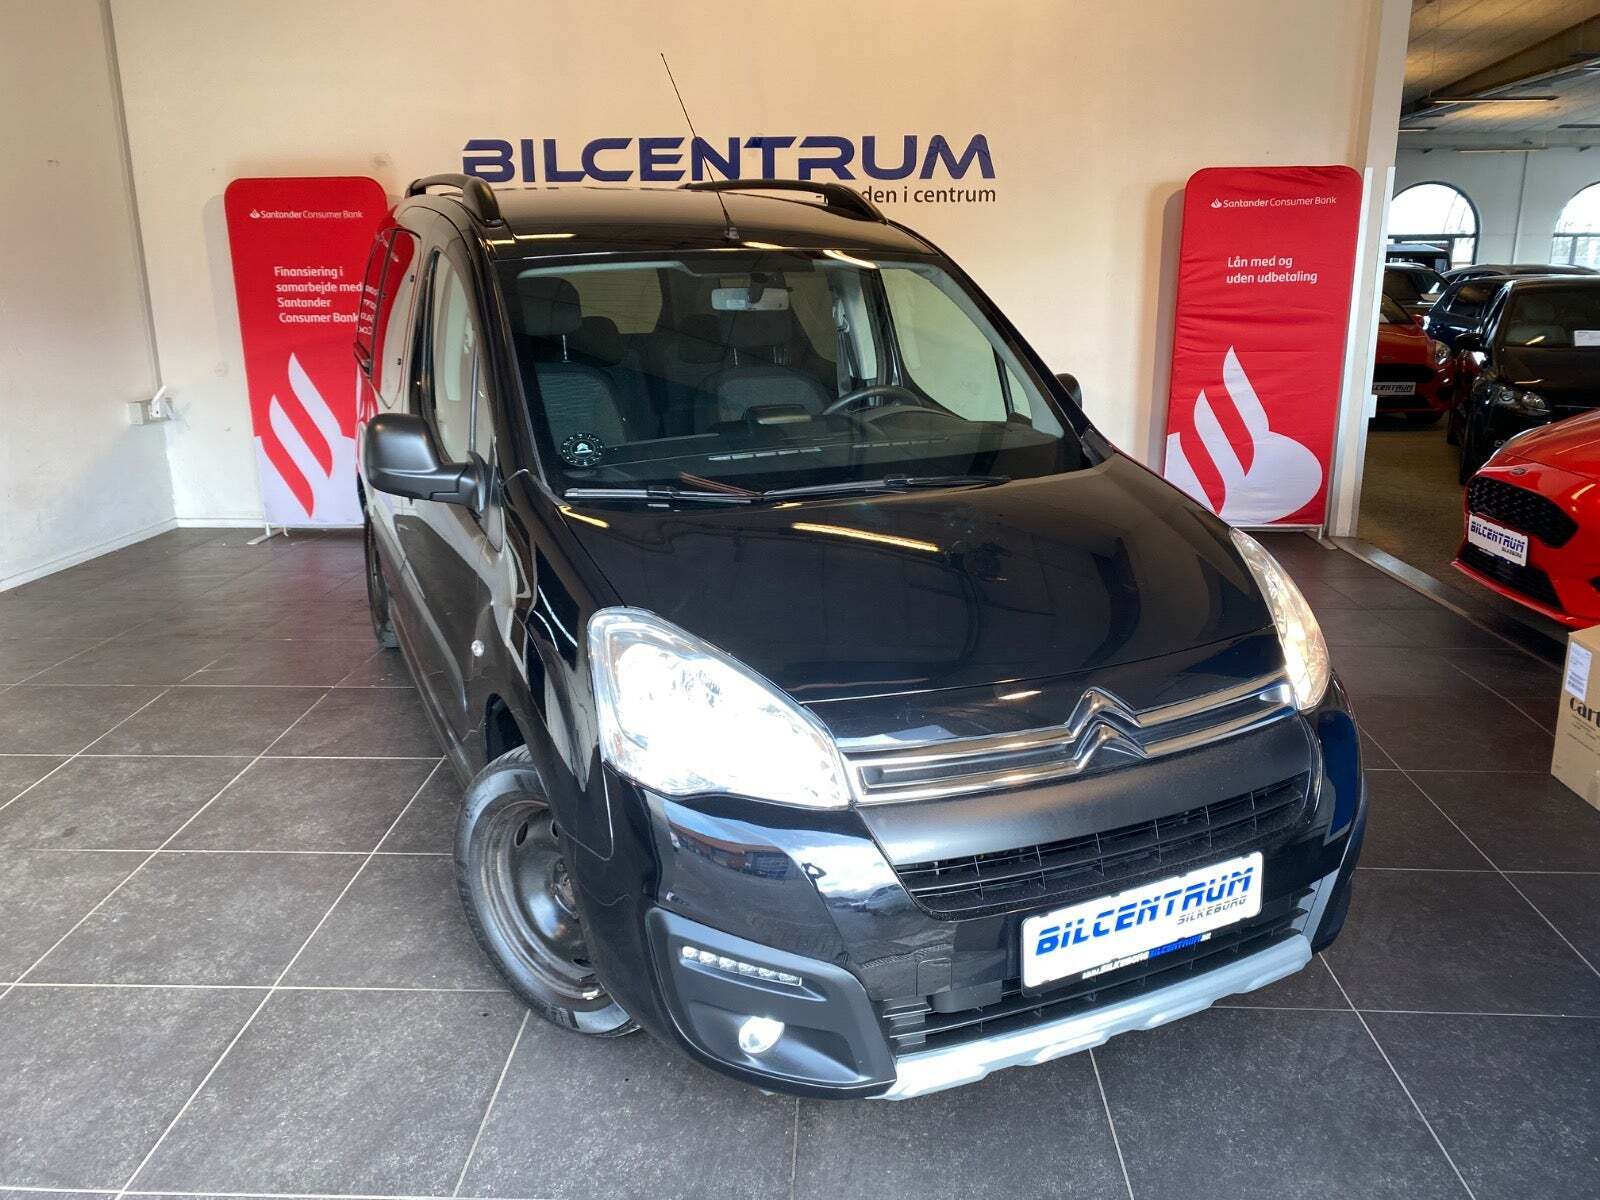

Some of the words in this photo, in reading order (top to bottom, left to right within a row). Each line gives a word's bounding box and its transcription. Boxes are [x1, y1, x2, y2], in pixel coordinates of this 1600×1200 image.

[462, 134, 996, 183] BILCENTRUM
[904, 185, 908, 203] i
[913, 187, 996, 203] centrum
[1223, 199, 1269, 208] Santander
[1269, 198, 1314, 207] Consumer
[1315, 196, 1337, 205] Bank
[260, 210, 302, 219] Santander
[302, 210, 342, 219] Consumer
[343, 210, 364, 218] Bank
[1227, 256, 1248, 268] Lån
[1250, 255, 1276, 266] med
[1278, 256, 1293, 268] og
[274, 266, 338, 279] Finansiering
[340, 266, 344, 277] i
[1226, 272, 1254, 284] uden
[1257, 271, 1318, 284] udbetaling
[276, 282, 337, 294] samarbejde
[339, 282, 363, 292] med
[278, 297, 331, 308] Santander
[279, 313, 331, 323] Consumer
[333, 312, 359, 322] Bank
[1471, 521, 1525, 553] BILCENTRUM
[1036, 867, 1253, 956] BILCENTRUM
[1177, 895, 1247, 925] SILKEBORG
